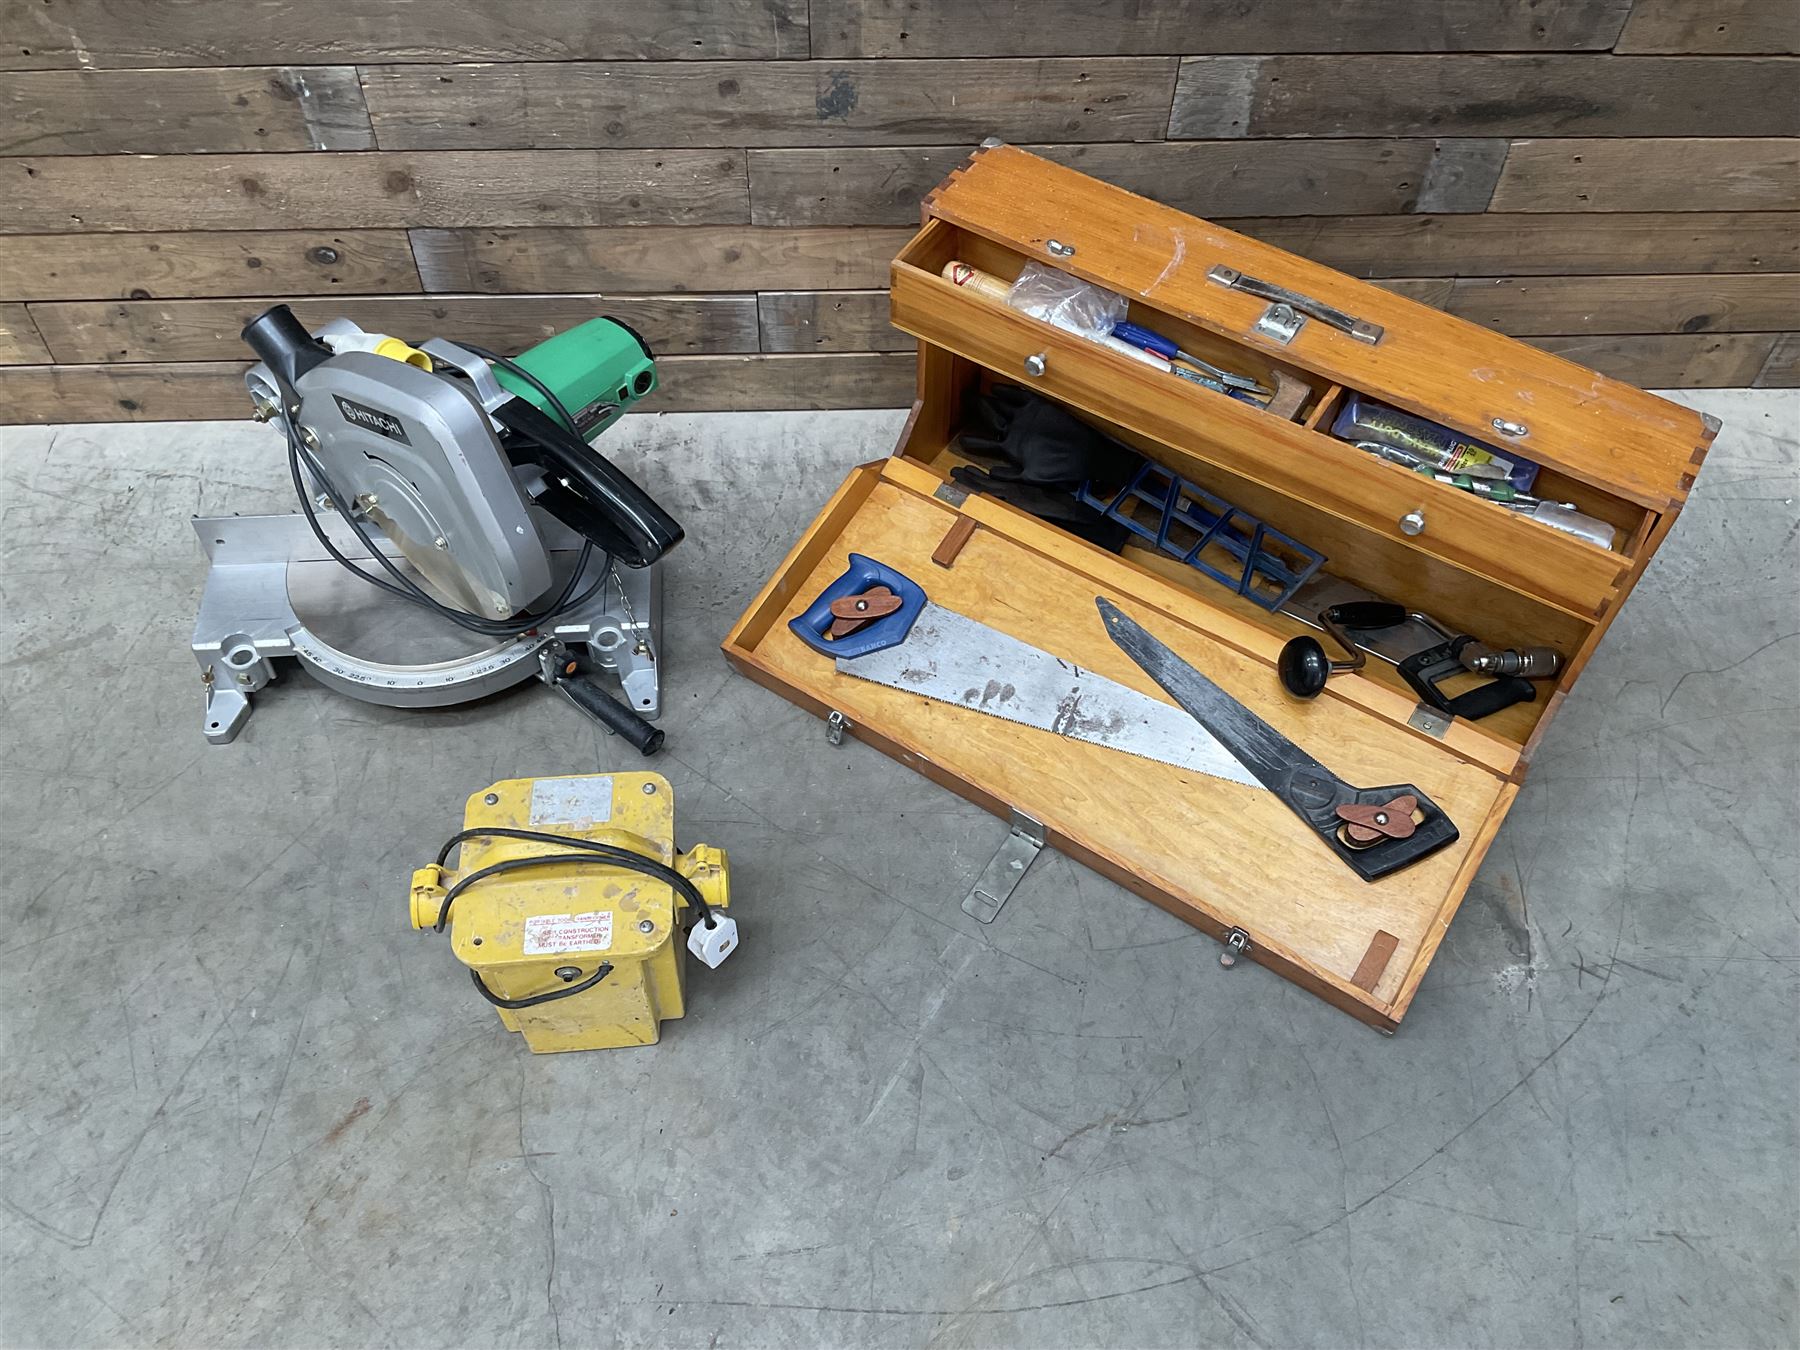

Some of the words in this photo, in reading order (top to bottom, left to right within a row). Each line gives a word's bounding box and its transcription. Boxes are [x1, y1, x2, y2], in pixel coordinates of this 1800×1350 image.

[353, 408, 402, 435] HITACHI
[1369, 419, 1401, 440] DUTY
[559, 926, 609, 935] CONSTRUCTION
